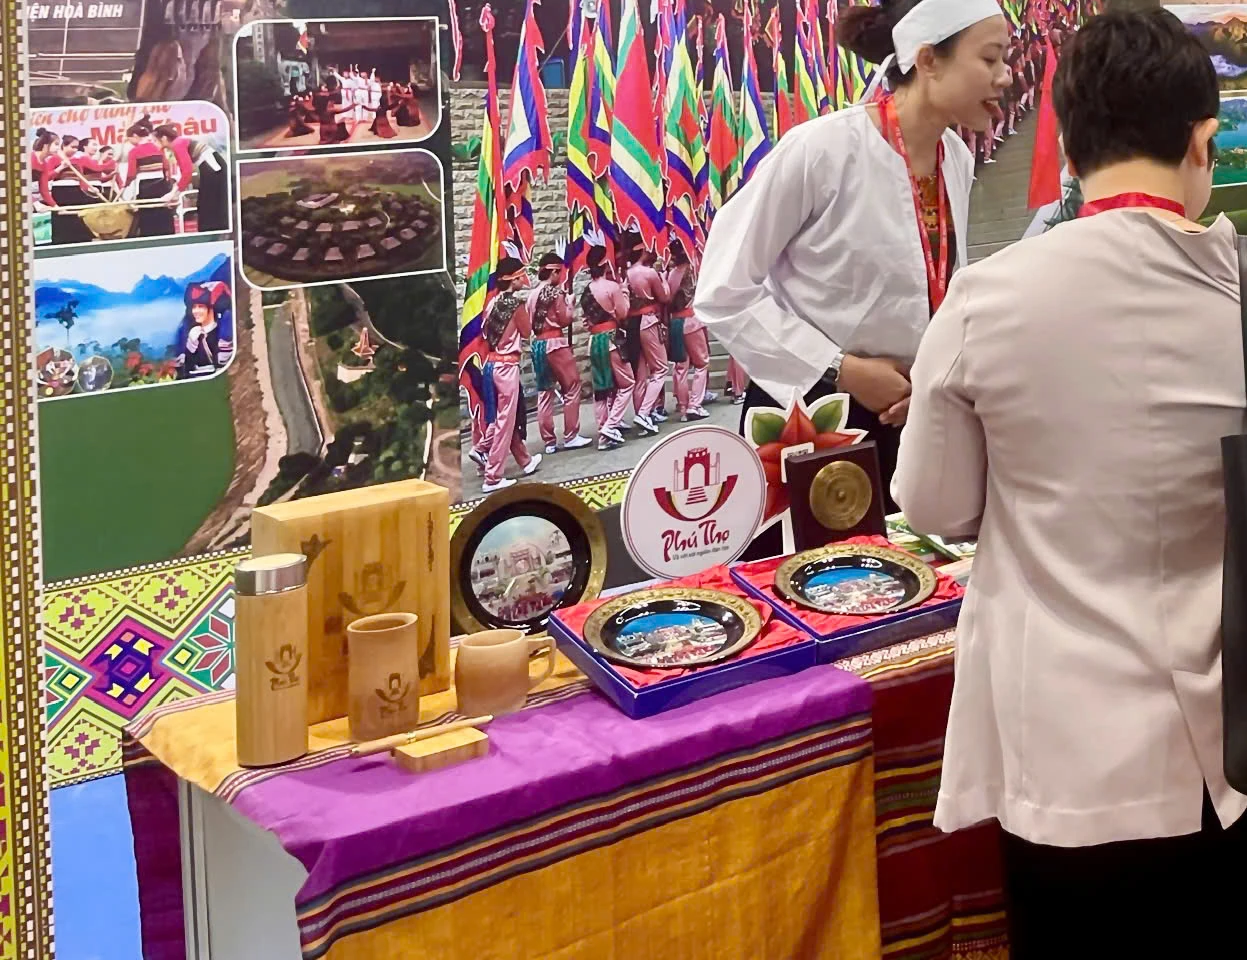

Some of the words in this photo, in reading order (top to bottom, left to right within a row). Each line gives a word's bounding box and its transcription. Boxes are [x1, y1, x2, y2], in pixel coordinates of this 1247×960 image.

[53, 2, 83, 19] HOÀ
[88, 1, 124, 19] BÌNH
[661, 529, 698, 562] Phú
